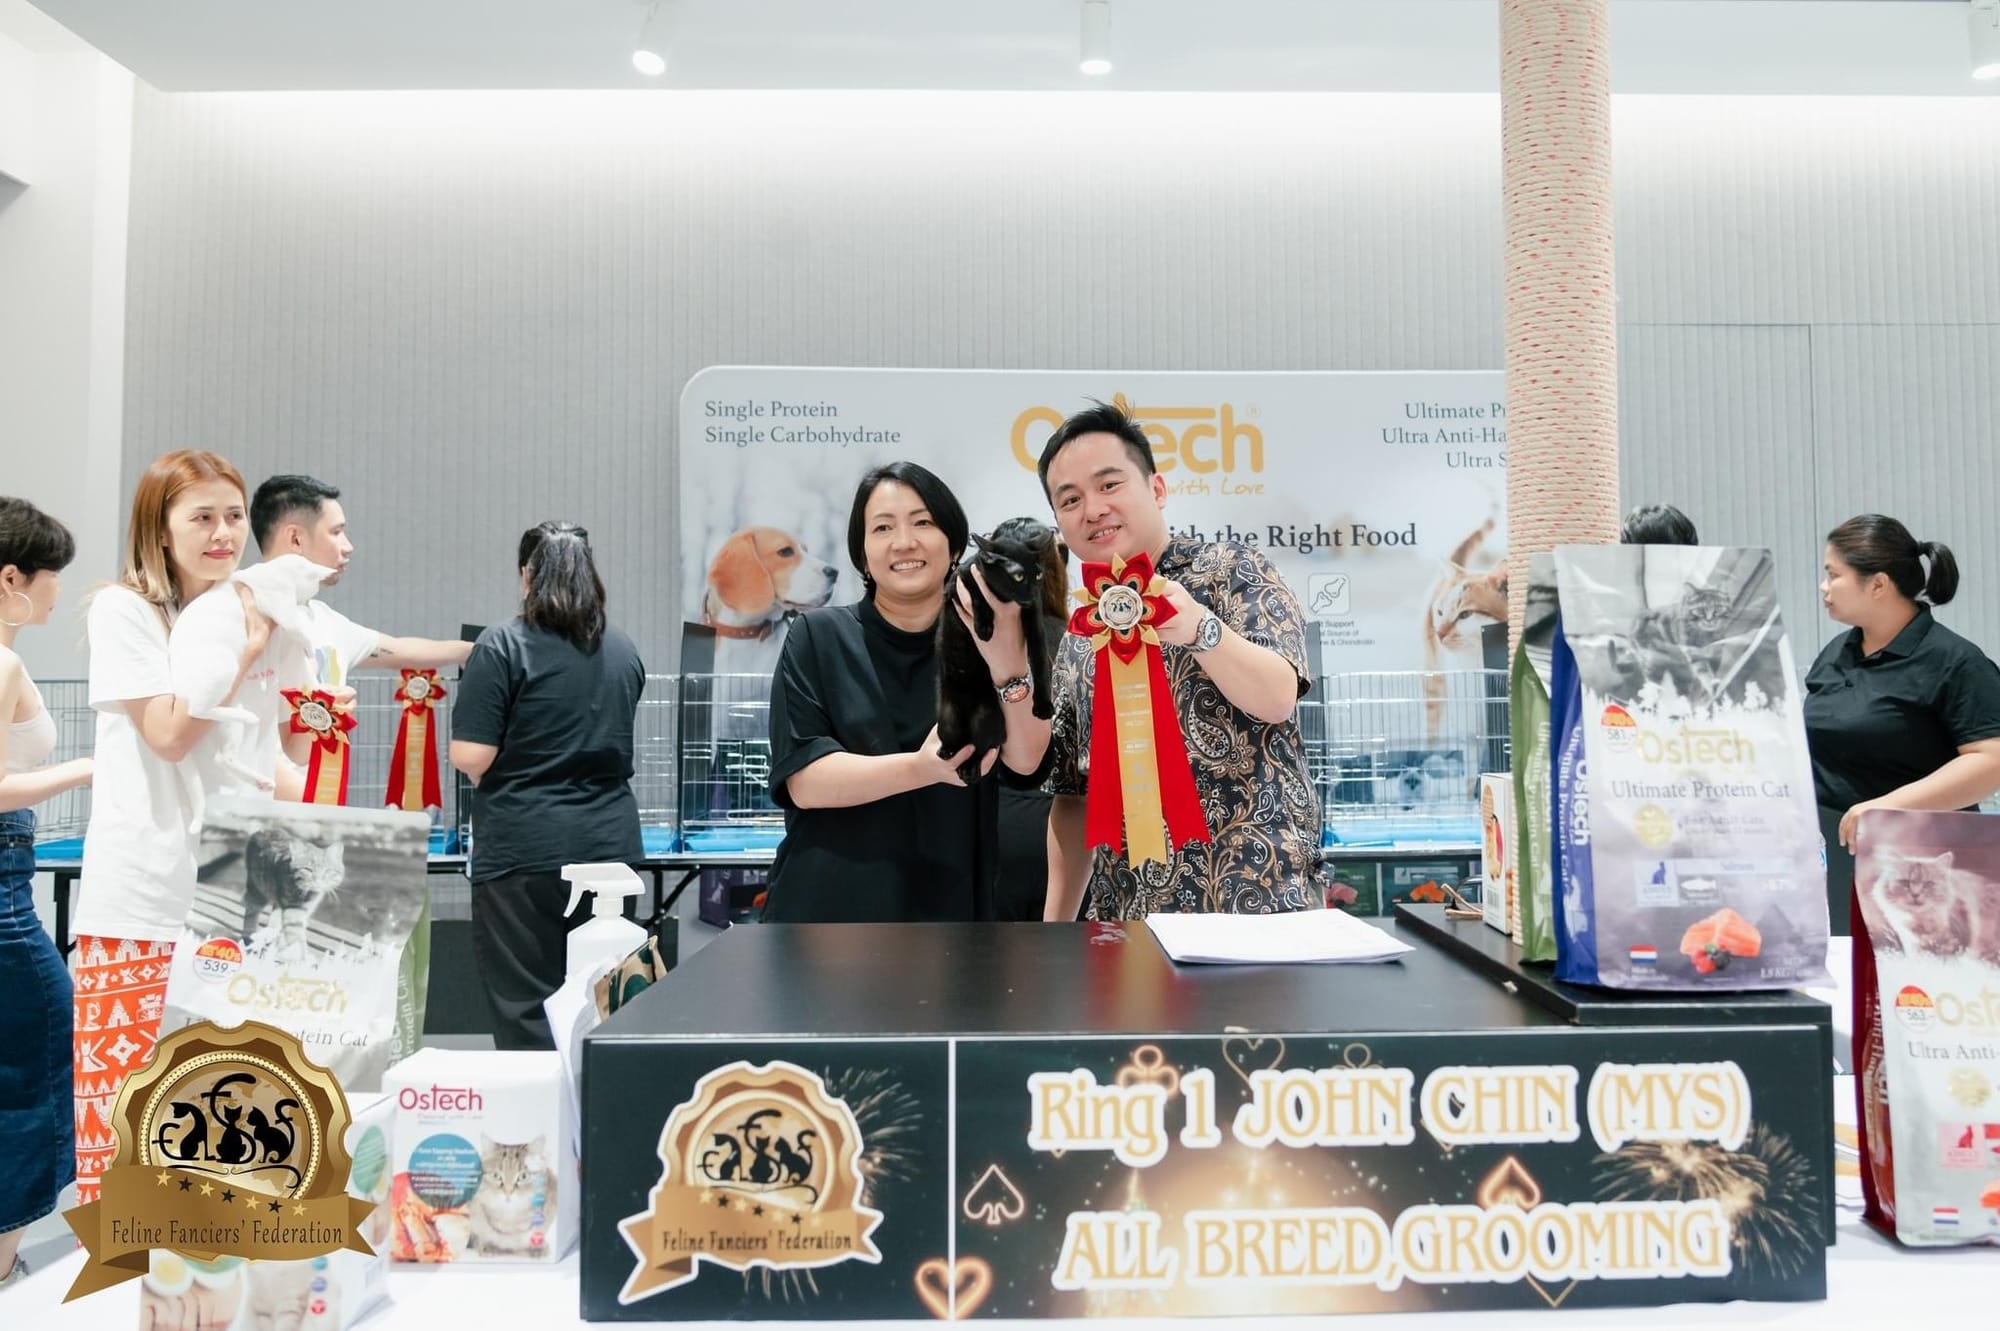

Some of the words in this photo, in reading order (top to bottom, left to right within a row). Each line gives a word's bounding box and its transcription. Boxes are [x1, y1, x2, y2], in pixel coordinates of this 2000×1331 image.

[705, 400, 765, 422] Single
[771, 400, 838, 418] Protein
[1405, 402, 1485, 419] Ultimate
[705, 426, 765, 447] Single
[771, 425, 901, 448] Carbohydrate
[1383, 427, 1429, 444] Ultra
[1446, 451, 1492, 468] Ultra
[1221, 477, 1264, 495] Love
[1215, 524, 1259, 547] the
[1267, 523, 1342, 554] Right
[1352, 523, 1418, 548] Food
[1638, 724, 1755, 764] Ostech
[1612, 779, 1688, 799] Ultimate
[1692, 780, 1757, 799] Protein
[1761, 780, 1792, 799] Cat
[227, 970, 348, 1014] Ostech
[1935, 985, 2000, 1028] Ost
[1908, 1041, 1950, 1059] Ultra
[399, 1083, 483, 1111] Ostech
[1036, 1075, 1162, 1160] Ring
[1187, 1075, 1213, 1141] 1
[1241, 1075, 1407, 1141] JOHN
[1429, 1072, 1572, 1138] CHIN
[1594, 1069, 1745, 1144] (MYS)
[662, 1228, 704, 1251] Feline
[709, 1229, 773, 1251] Fanciers'
[777, 1229, 852, 1251] Federation
[1061, 1217, 1172, 1283] ALL
